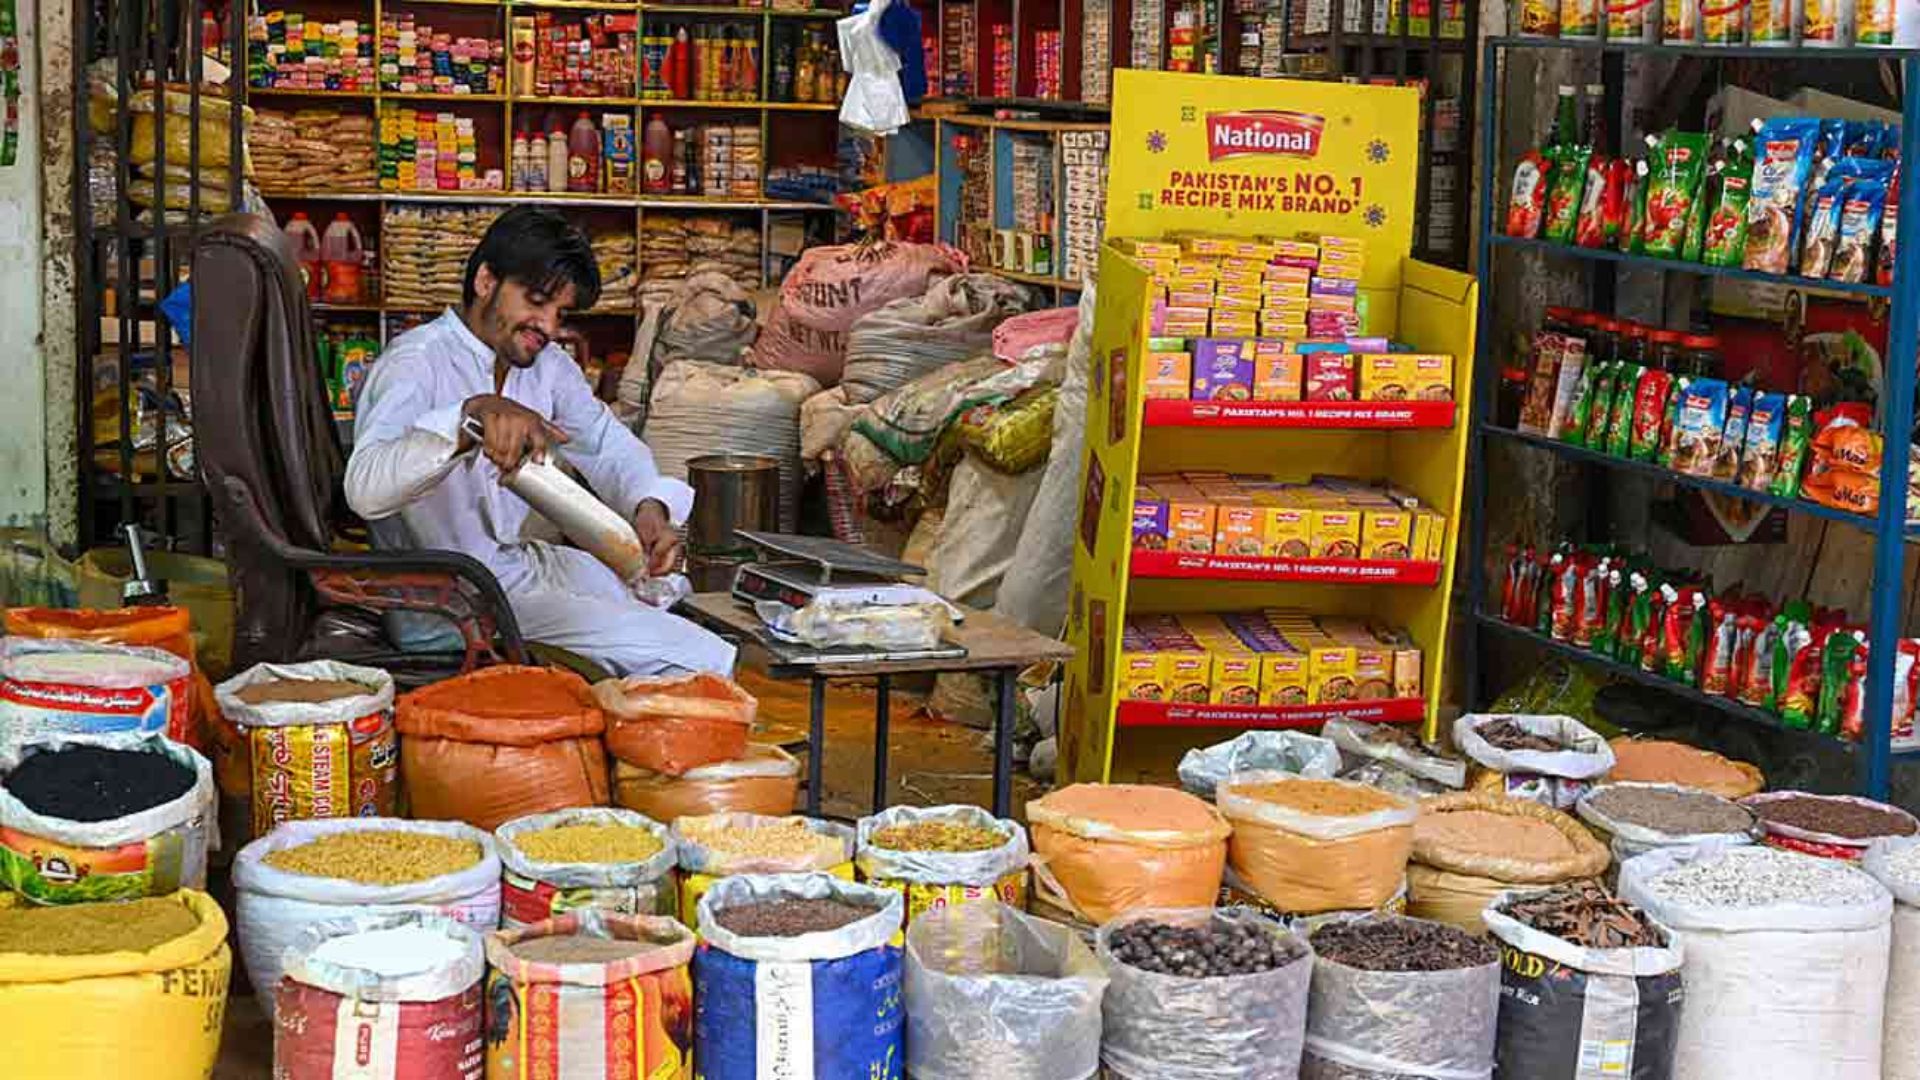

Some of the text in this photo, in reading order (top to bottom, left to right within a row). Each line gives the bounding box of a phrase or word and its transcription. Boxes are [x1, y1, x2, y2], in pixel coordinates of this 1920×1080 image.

[1214, 121, 1312, 151] National
[1170, 170, 1362, 197] PAKISTAN'S NO. 1
[1161, 188, 1232, 208] RECIPE
[1238, 193, 1275, 211] MIX
[313, 745, 331, 793] STEAM
[1501, 945, 1544, 977] OLD
